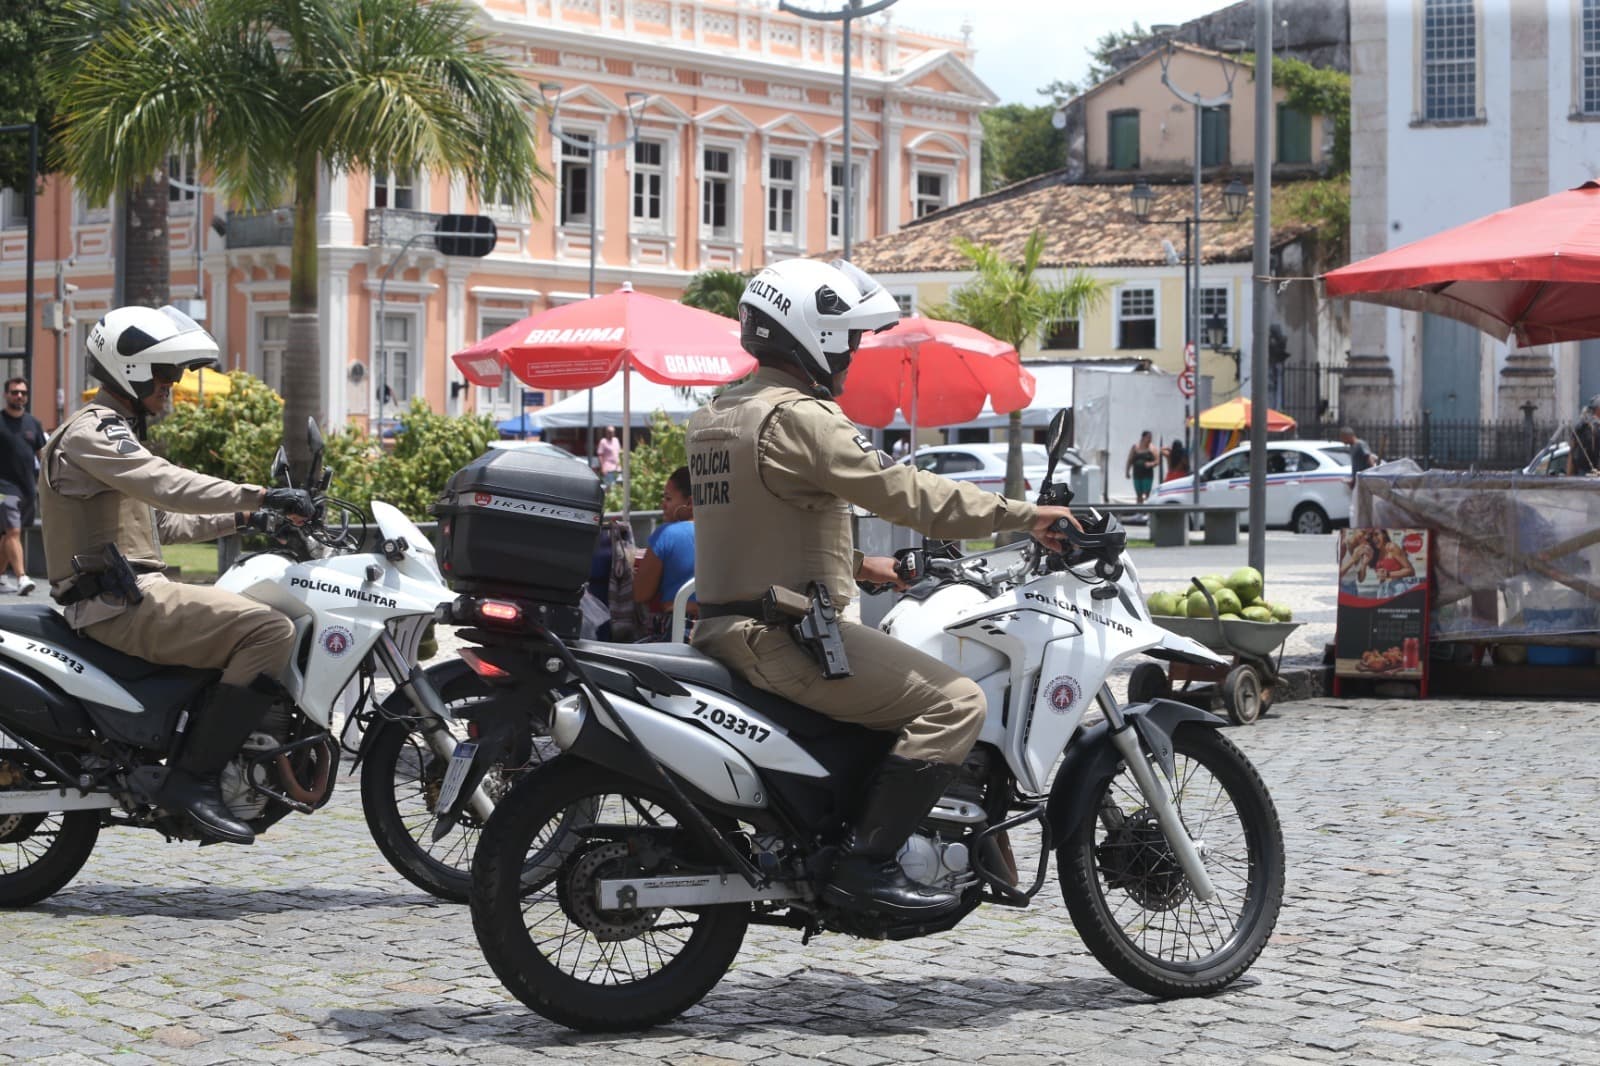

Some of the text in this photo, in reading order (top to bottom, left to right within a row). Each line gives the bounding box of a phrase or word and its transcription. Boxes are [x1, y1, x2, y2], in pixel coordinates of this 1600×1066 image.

[749, 280, 792, 316] MILITAR
[523, 327, 625, 345] BRAHMA
[664, 355, 734, 375] BRAHMA
[690, 447, 731, 476] POLÍCIA
[493, 500, 572, 516] TRAFFIC
[291, 577, 397, 609] POLÍCIA MILITAR
[1082, 608, 1134, 637] MILITAR
[26, 642, 85, 674] 7.03313
[692, 700, 771, 744] 7.03317
